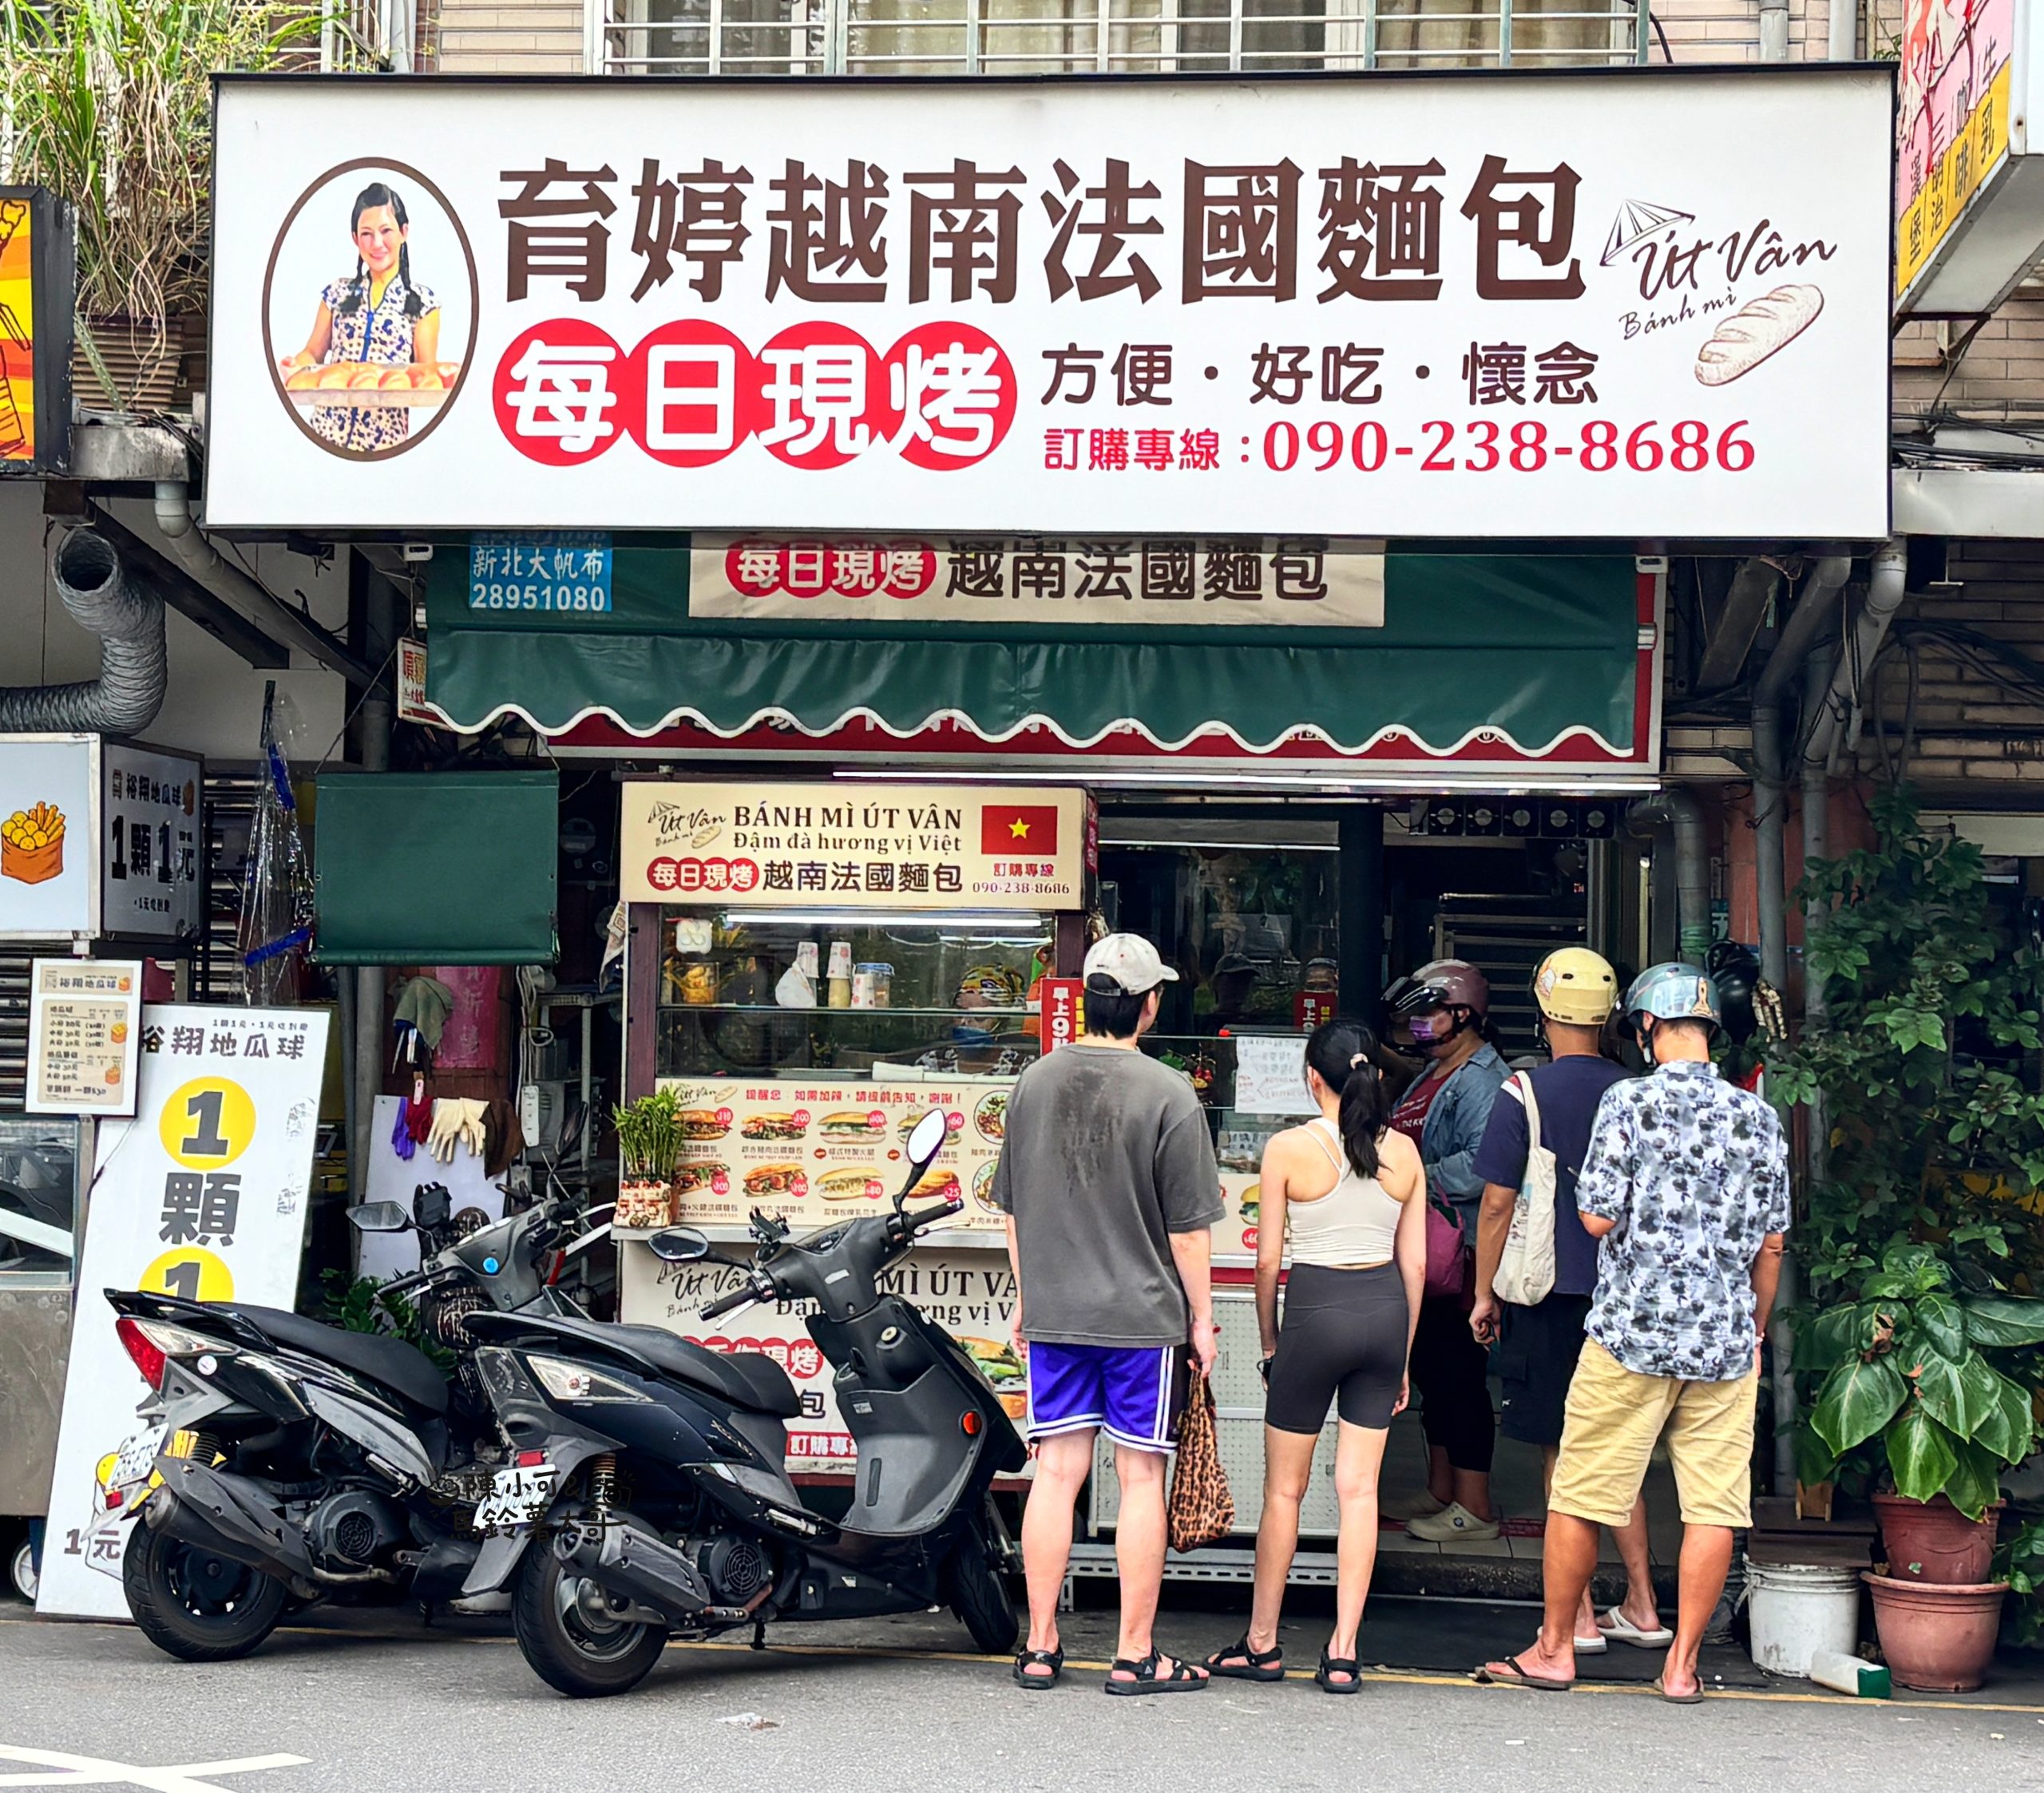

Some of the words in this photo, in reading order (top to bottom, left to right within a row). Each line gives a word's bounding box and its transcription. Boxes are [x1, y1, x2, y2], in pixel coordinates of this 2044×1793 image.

[497, 154, 1586, 304] 育婷越南法國麵包
[1632, 230, 1713, 300] Út
[1717, 219, 1837, 283] Vân
[1618, 294, 1695, 340] Bánh
[505, 340, 1003, 457] 每日現烤
[473, 547, 604, 582] 新北大帆布
[737, 548, 924, 589] 每日現烤
[471, 584, 604, 611] 28951080
[734, 801, 812, 827] BÁNH
[822, 802, 854, 828] MÌ
[863, 802, 900, 829] ÚT
[907, 803, 962, 829] VÂN
[734, 832, 781, 853] Đậm
[787, 833, 811, 849] đà
[818, 833, 889, 855] hương
[895, 835, 913, 854] vị
[918, 834, 962, 856] Việt
[652, 862, 753, 888] 每日現烤
[763, 860, 963, 893] 越南法國麵包
[711, 1265, 748, 1293] Vâ
[929, 1263, 974, 1296] ÚT
[968, 1301, 990, 1325] vị
